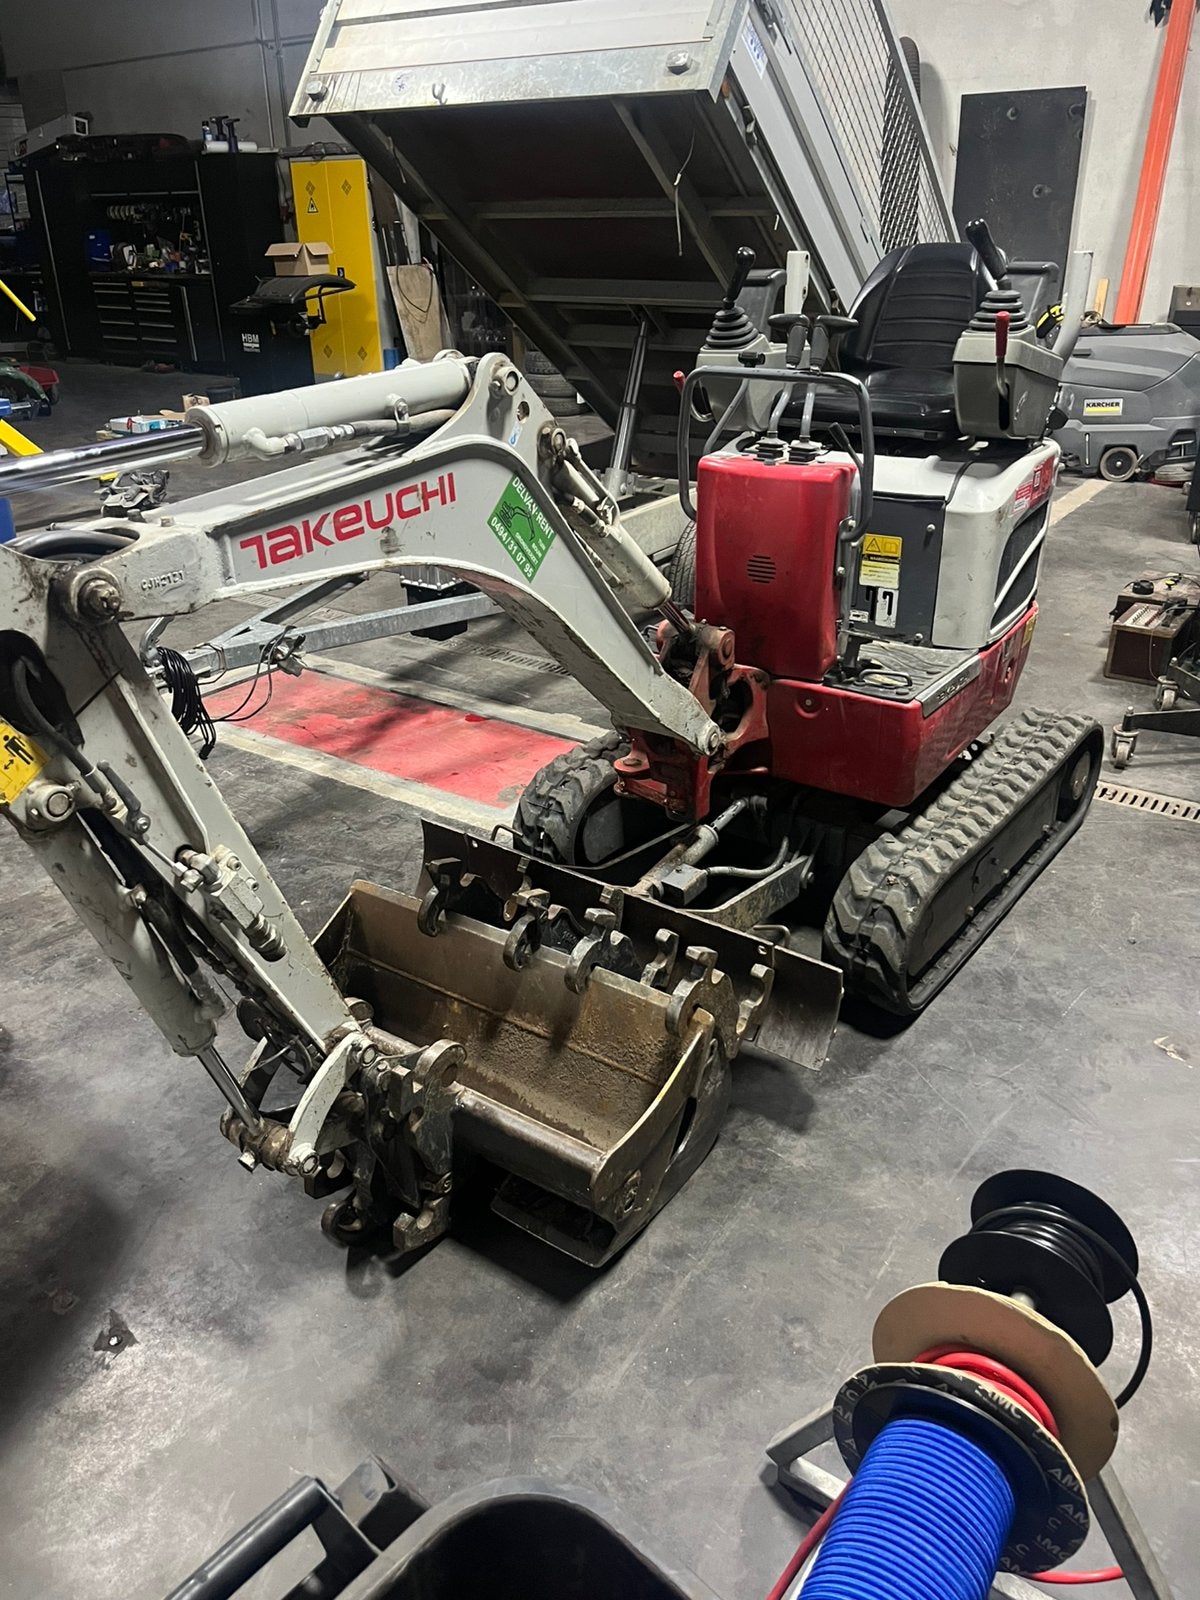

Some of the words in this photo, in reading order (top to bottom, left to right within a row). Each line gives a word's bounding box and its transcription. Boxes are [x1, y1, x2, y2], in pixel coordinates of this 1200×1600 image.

[241, 333, 259, 343] HBM
[516, 552, 526, 565] 07
[523, 563, 534, 578] 95
[1047, 1468, 1081, 1492] AM
